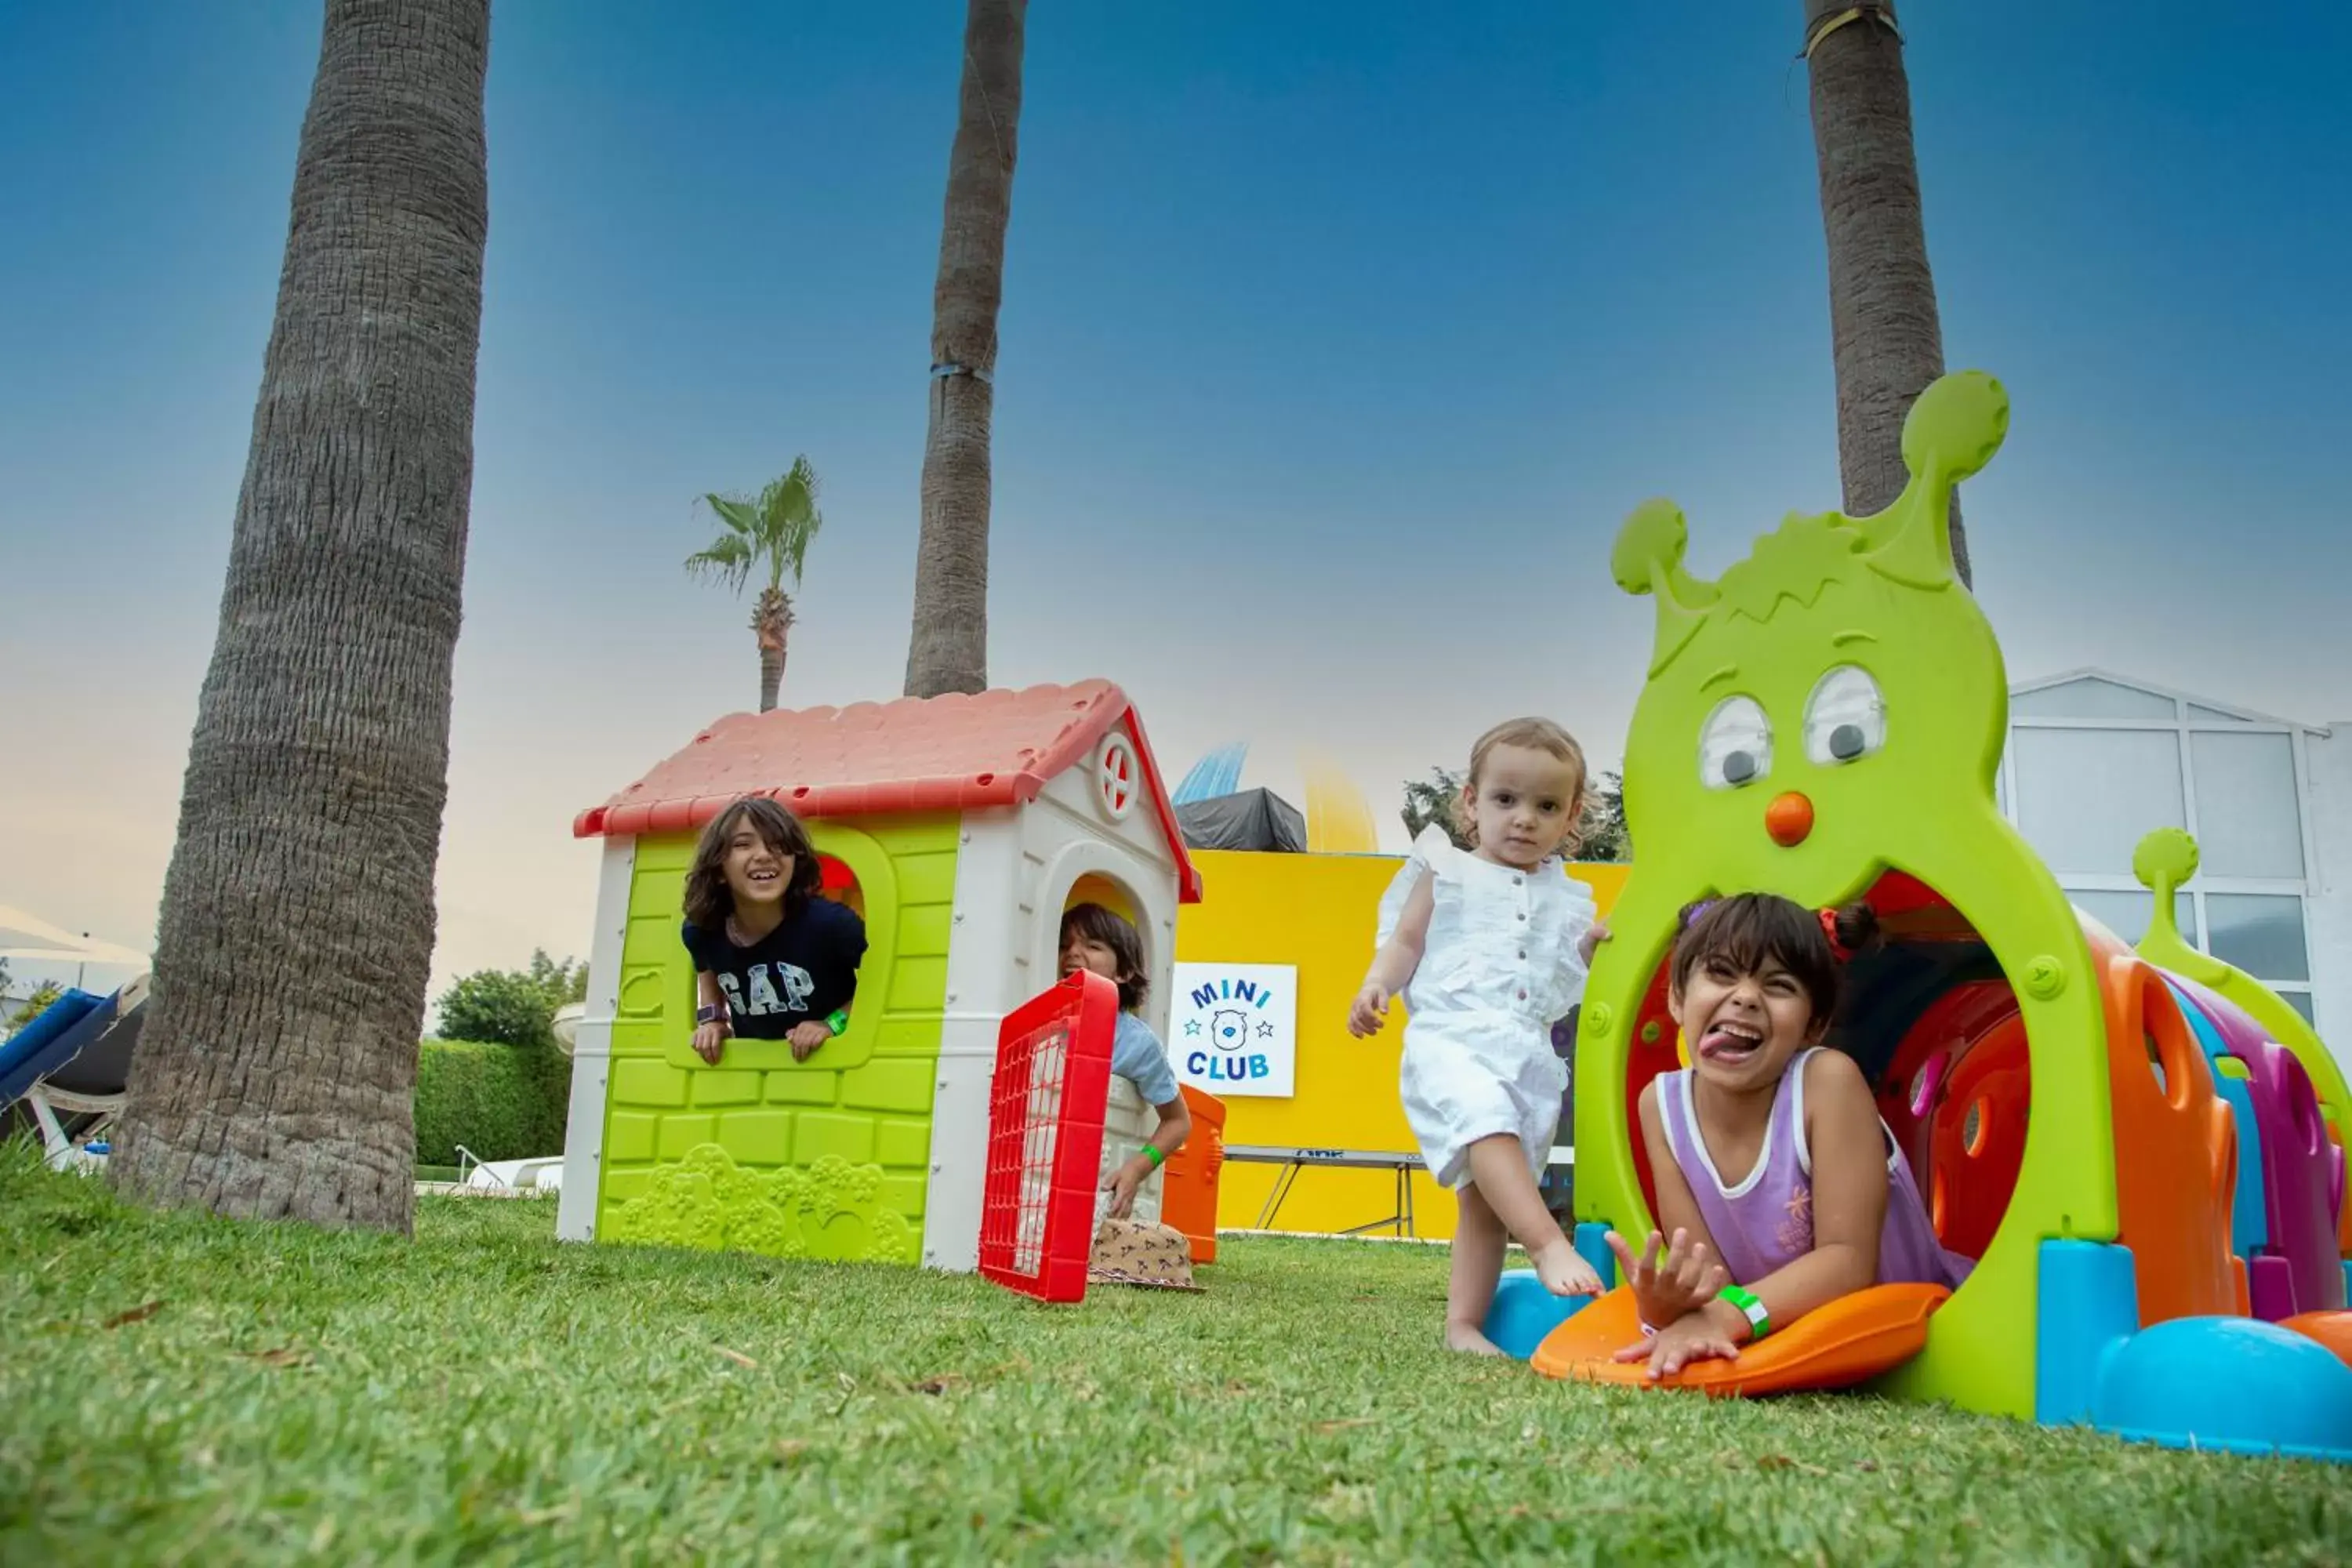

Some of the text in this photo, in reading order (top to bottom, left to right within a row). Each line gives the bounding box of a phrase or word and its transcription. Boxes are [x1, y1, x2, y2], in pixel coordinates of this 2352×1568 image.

[717, 961, 815, 1015] GAP
[1191, 979, 1272, 1010] MINI
[1187, 1051, 1269, 1080] CLUB
